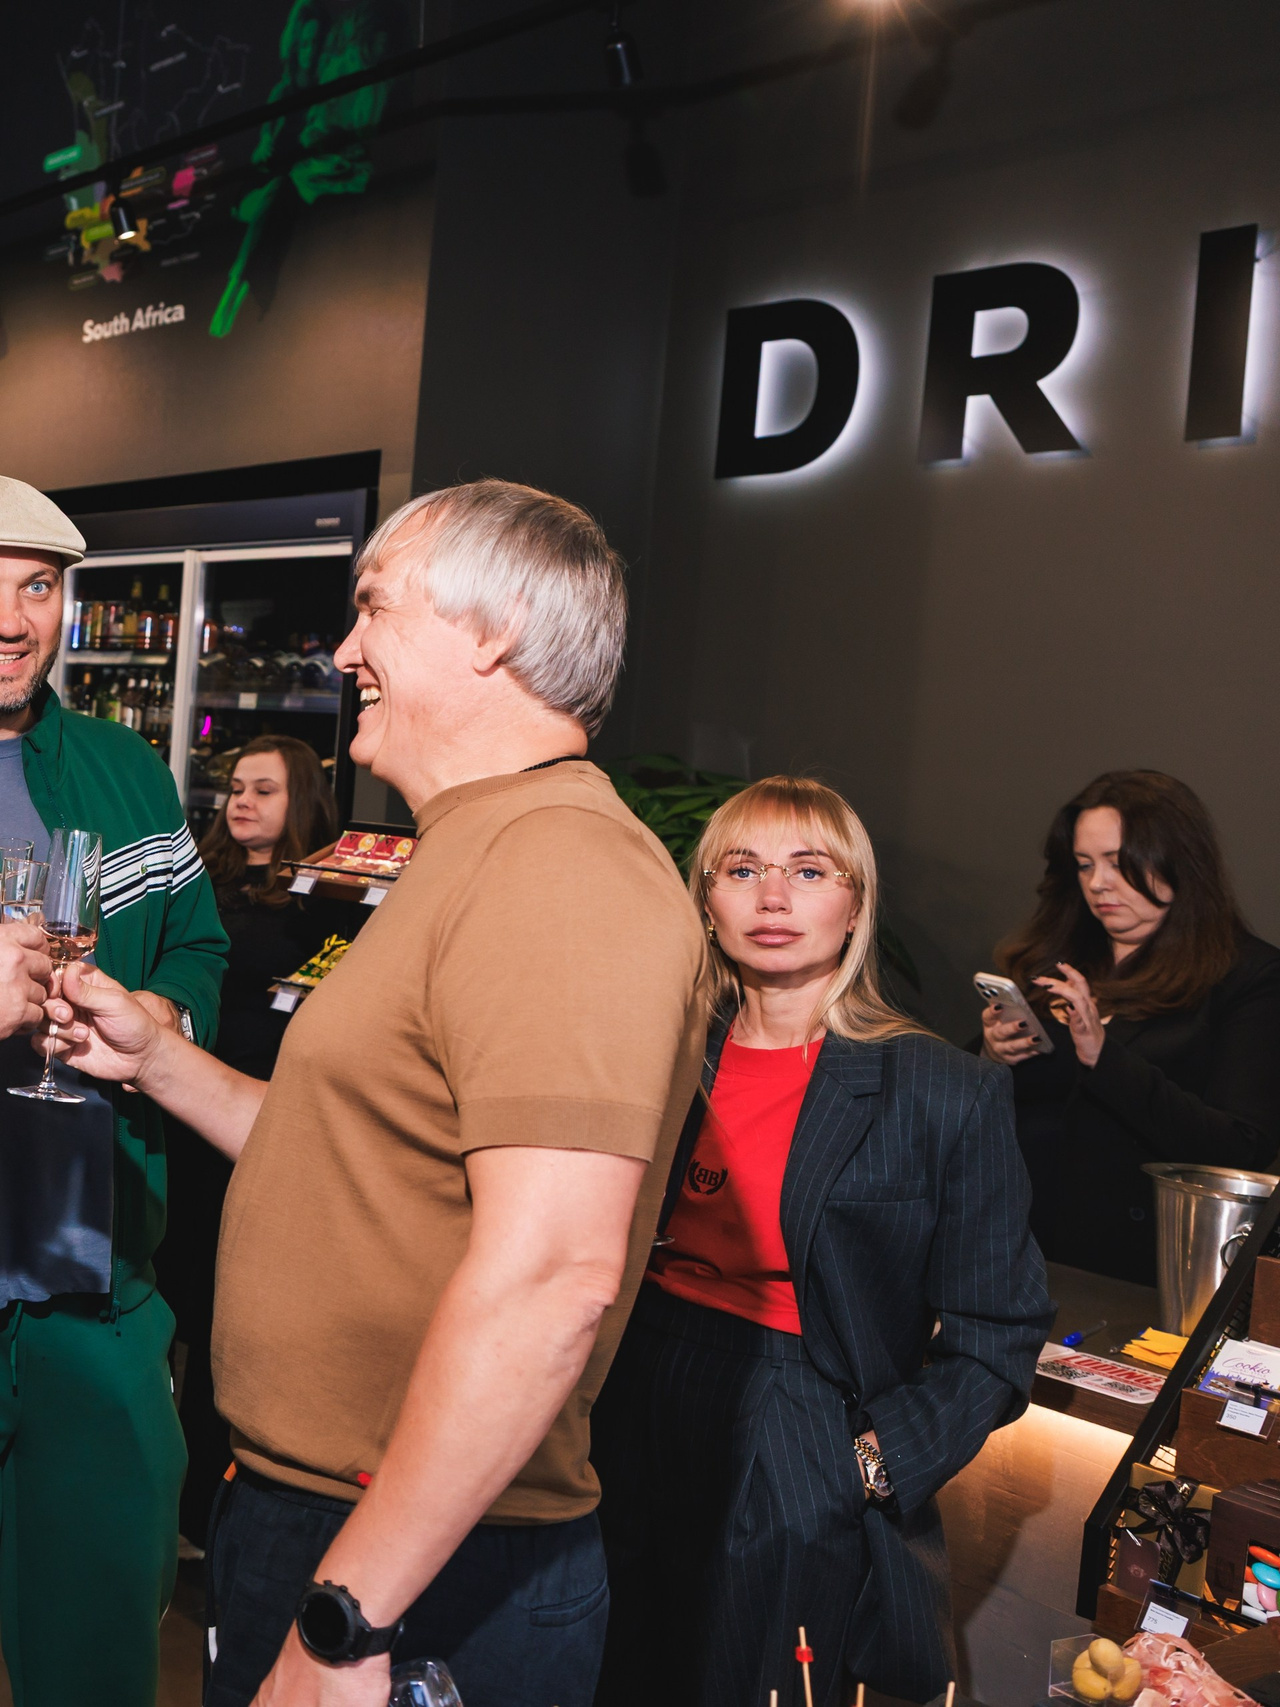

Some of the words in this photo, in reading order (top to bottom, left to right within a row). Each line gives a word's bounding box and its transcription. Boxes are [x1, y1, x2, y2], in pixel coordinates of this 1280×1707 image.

[82, 317, 130, 344] South
[131, 301, 186, 332] Africa
[715, 224, 1258, 479] DRI
